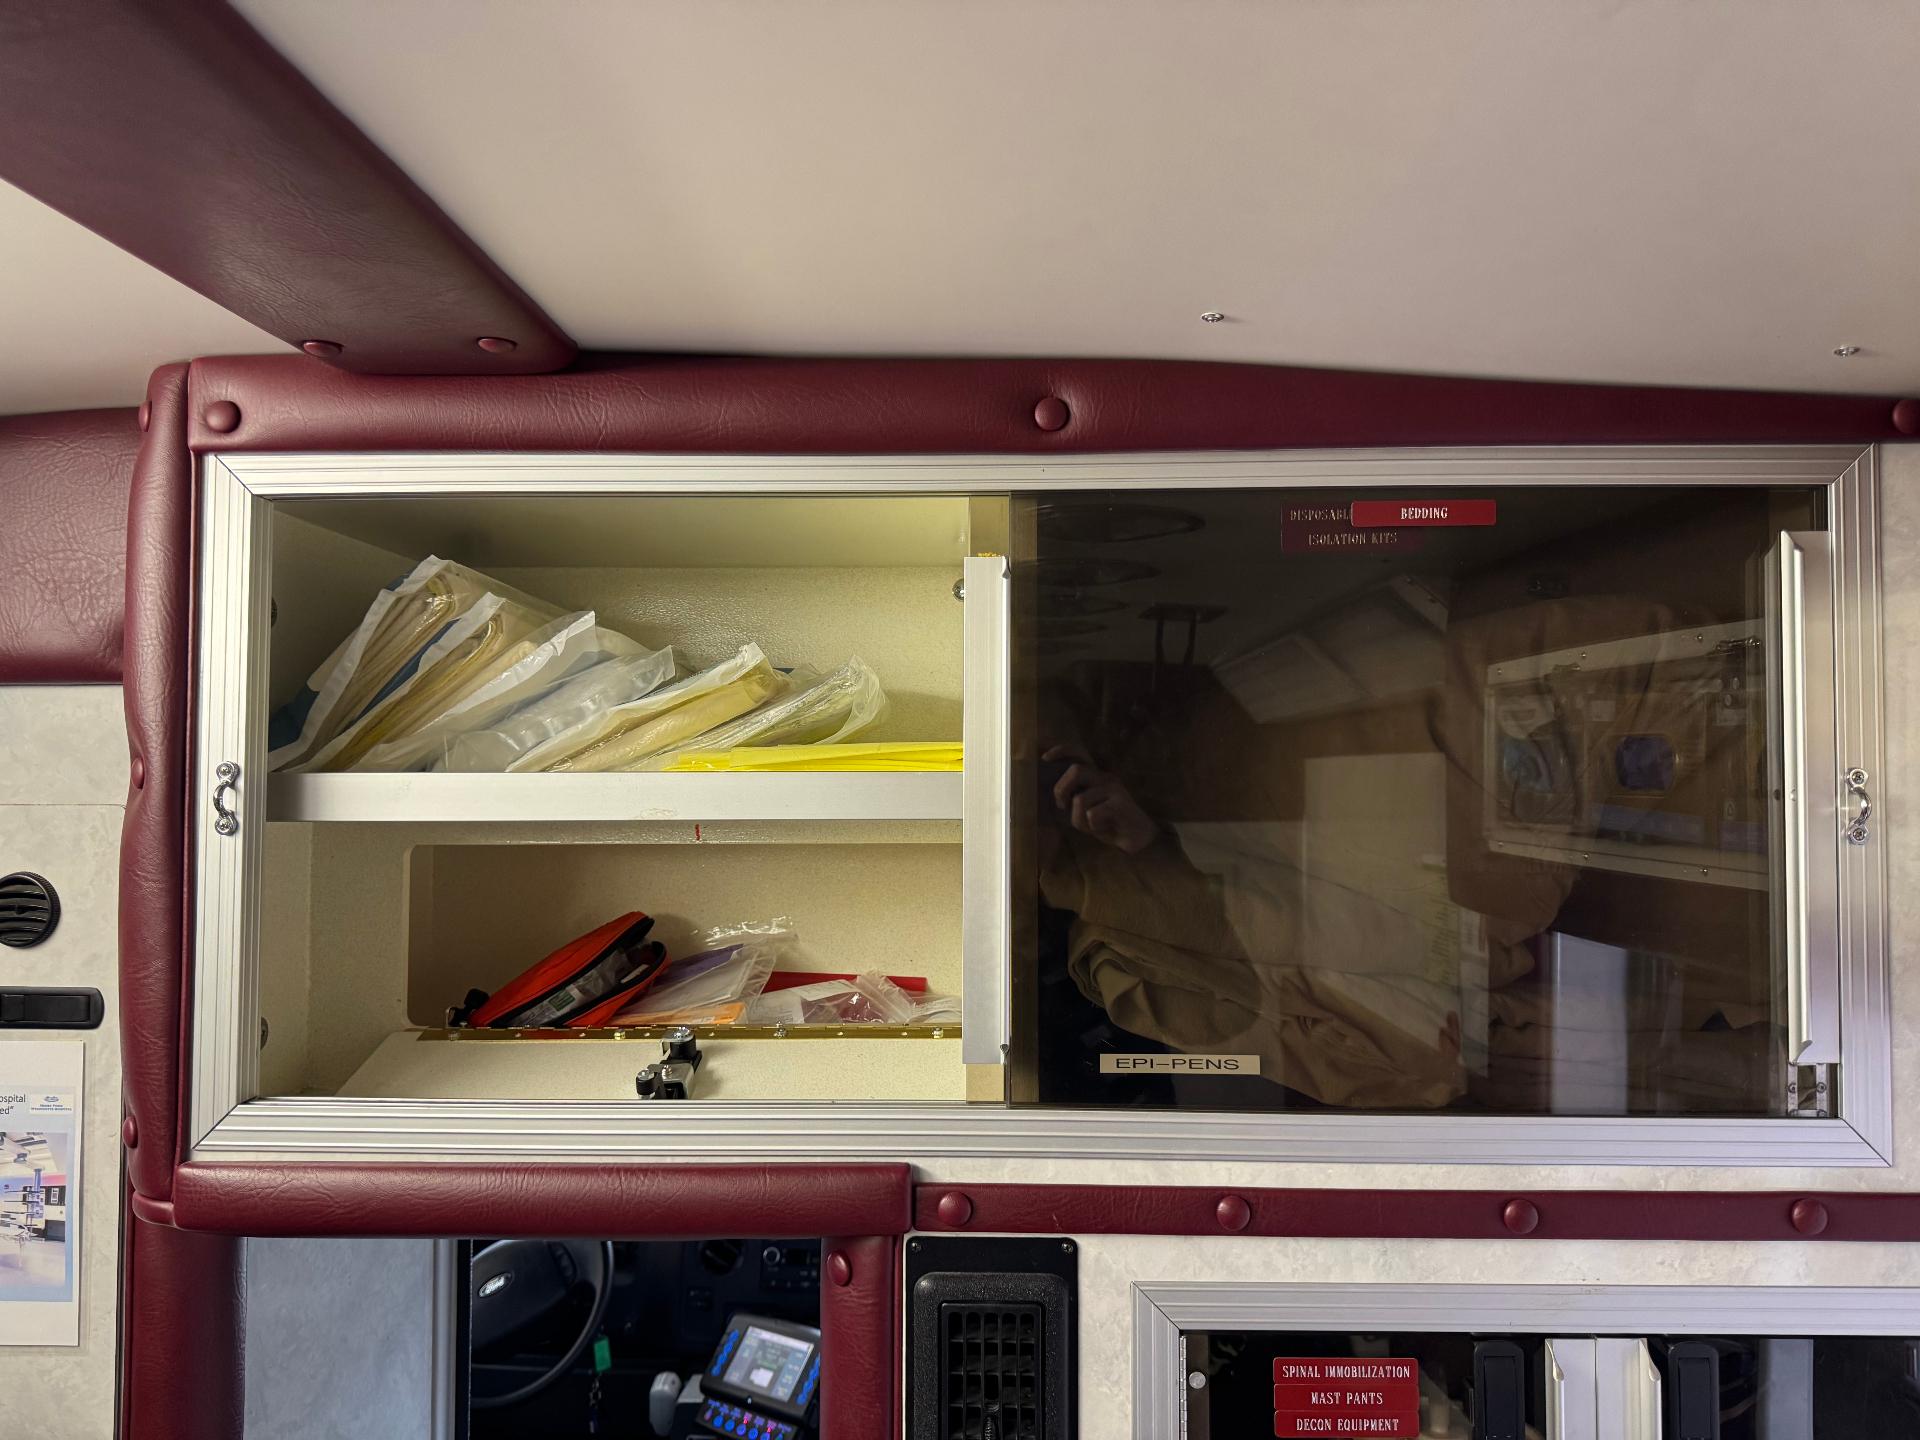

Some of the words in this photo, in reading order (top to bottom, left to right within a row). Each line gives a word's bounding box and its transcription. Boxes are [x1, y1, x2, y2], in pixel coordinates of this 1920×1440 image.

[1290, 508, 1351, 520] DISPOSABL
[1400, 507, 1448, 519] BEDDING
[1308, 533, 1366, 545] ISOLATION
[1371, 532, 1397, 544] KITS
[1115, 1058, 1240, 1070] EPI-PENS
[1282, 1365, 1321, 1378] SPINAL
[1325, 1365, 1410, 1378] IMMOBILIZATION
[1311, 1392, 1341, 1405] MAST
[1346, 1392, 1383, 1405] PANTS
[1296, 1418, 1332, 1431] DECON
[1337, 1418, 1399, 1431] EQUIPMENT
